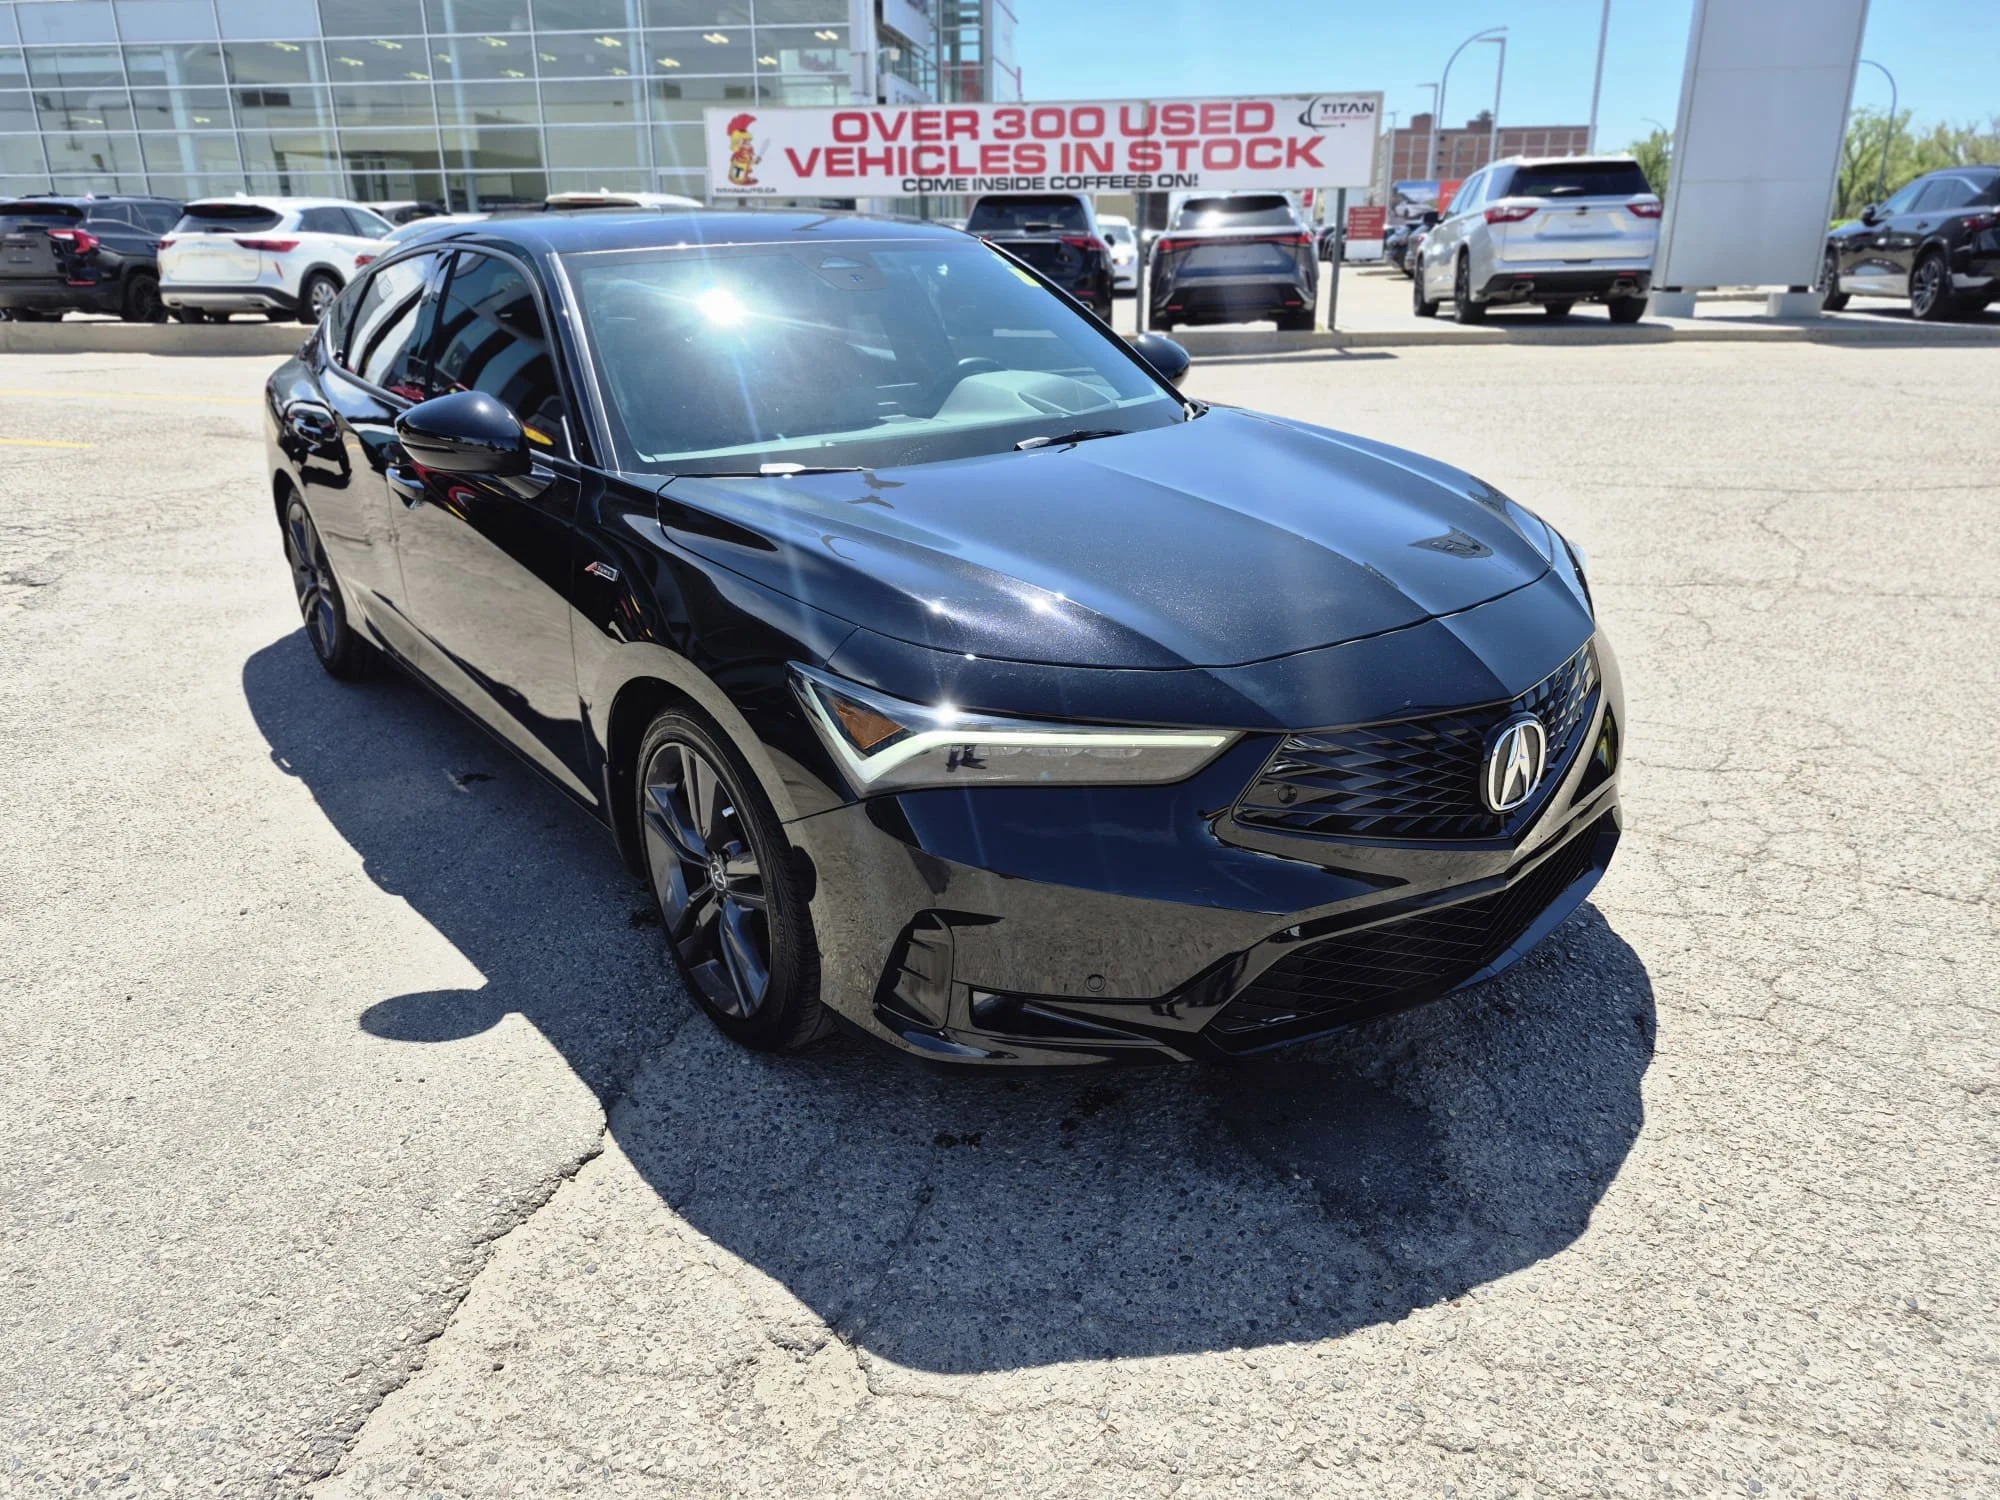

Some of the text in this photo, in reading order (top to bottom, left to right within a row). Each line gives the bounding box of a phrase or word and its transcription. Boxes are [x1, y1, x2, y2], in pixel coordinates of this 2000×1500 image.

[832, 102, 1275, 143] OVER 300 USED
[1321, 102, 1375, 114] TITAN
[785, 136, 1325, 178] VEHICLES IN STOCK
[902, 173, 1199, 192] COME INSIDE COFFEES ON!
